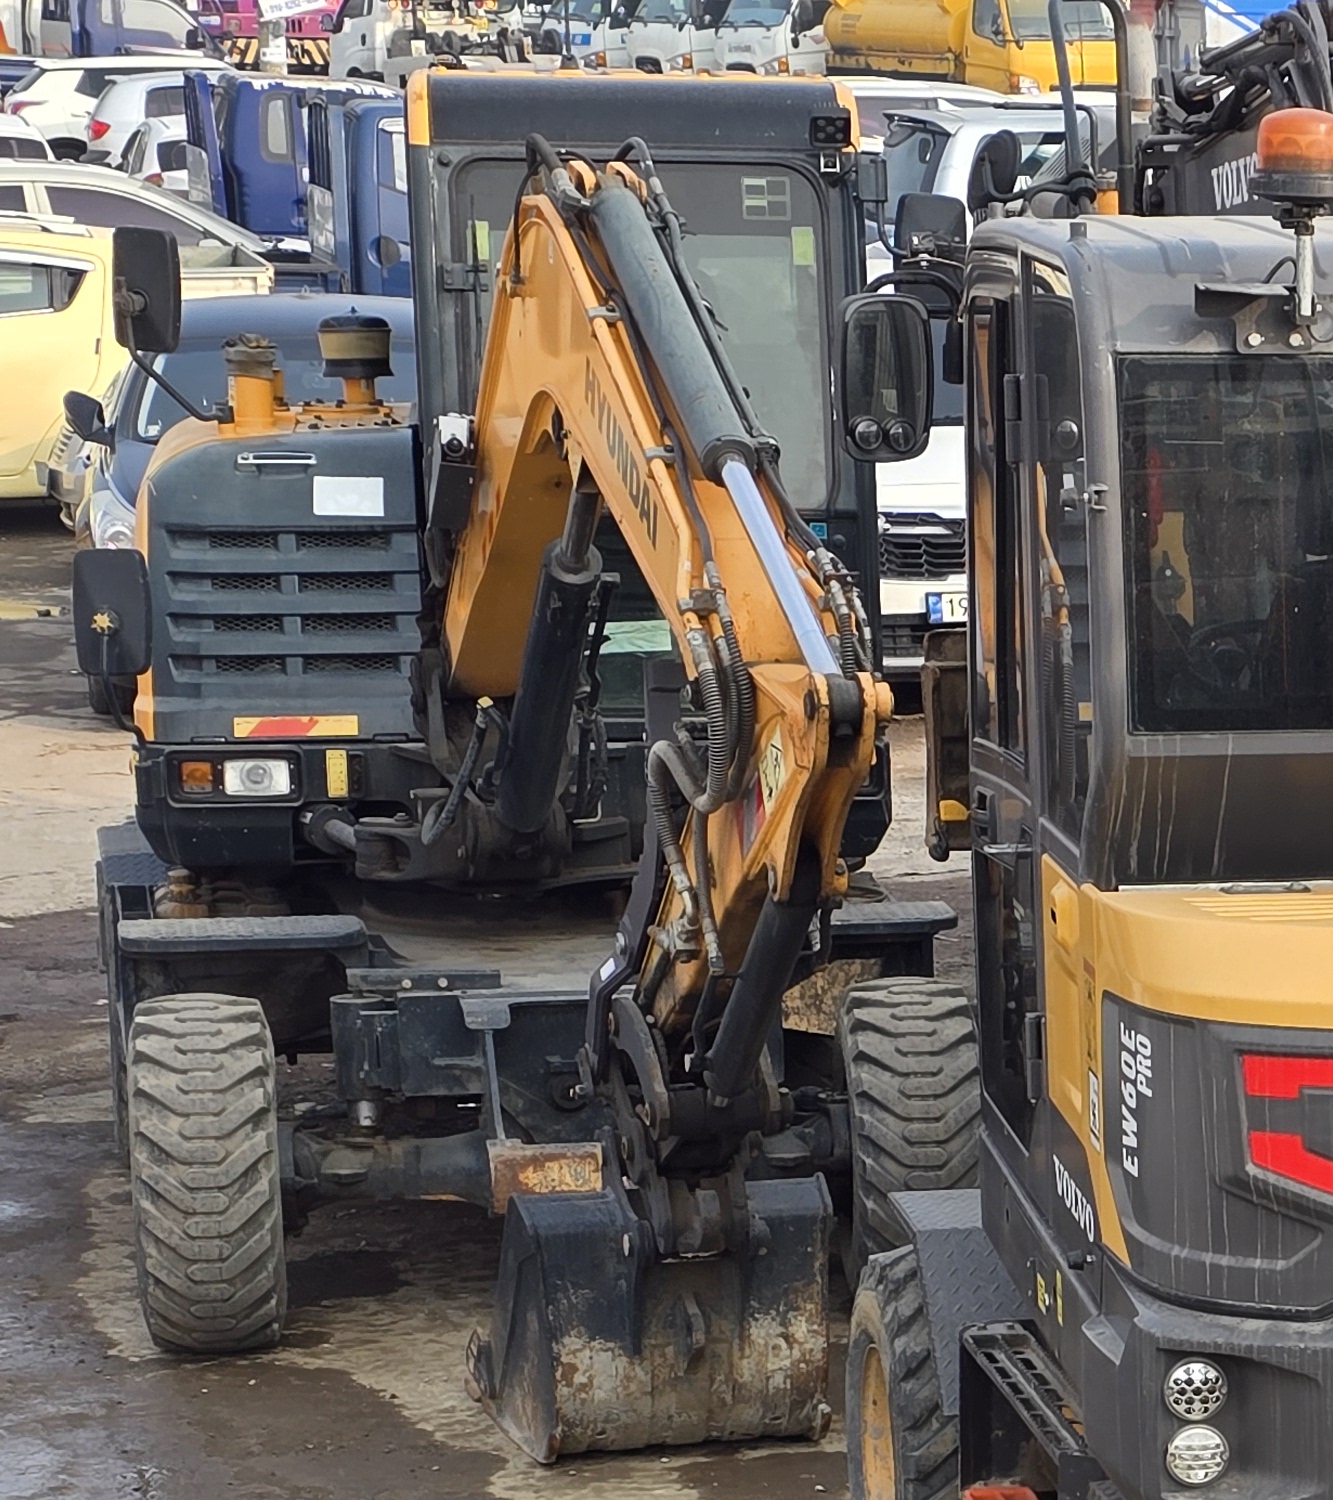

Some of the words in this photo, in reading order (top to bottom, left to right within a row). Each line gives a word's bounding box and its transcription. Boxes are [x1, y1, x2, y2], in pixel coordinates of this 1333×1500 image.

[584, 355, 659, 551] HYUNDAI
[1120, 1021, 1139, 1178] EW60E
[1136, 1033, 1153, 1098] PRO
[1053, 1154, 1095, 1243] VOLVO
